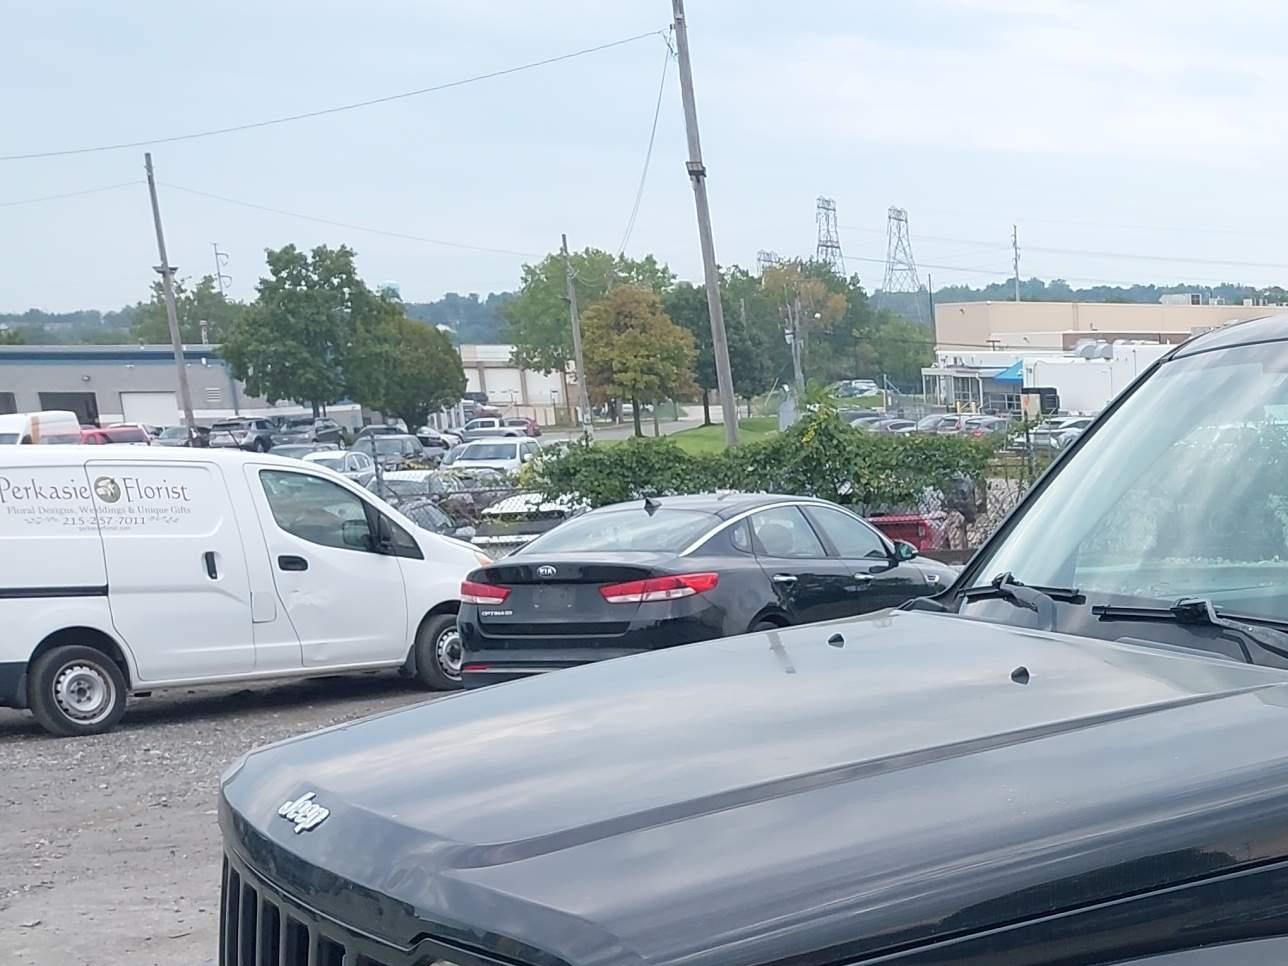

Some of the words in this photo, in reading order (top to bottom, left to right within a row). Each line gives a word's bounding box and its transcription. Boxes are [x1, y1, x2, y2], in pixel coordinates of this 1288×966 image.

[0, 476, 90, 503] Perkasie
[122, 477, 190, 502] Florist
[278, 792, 330, 834] Jeep
